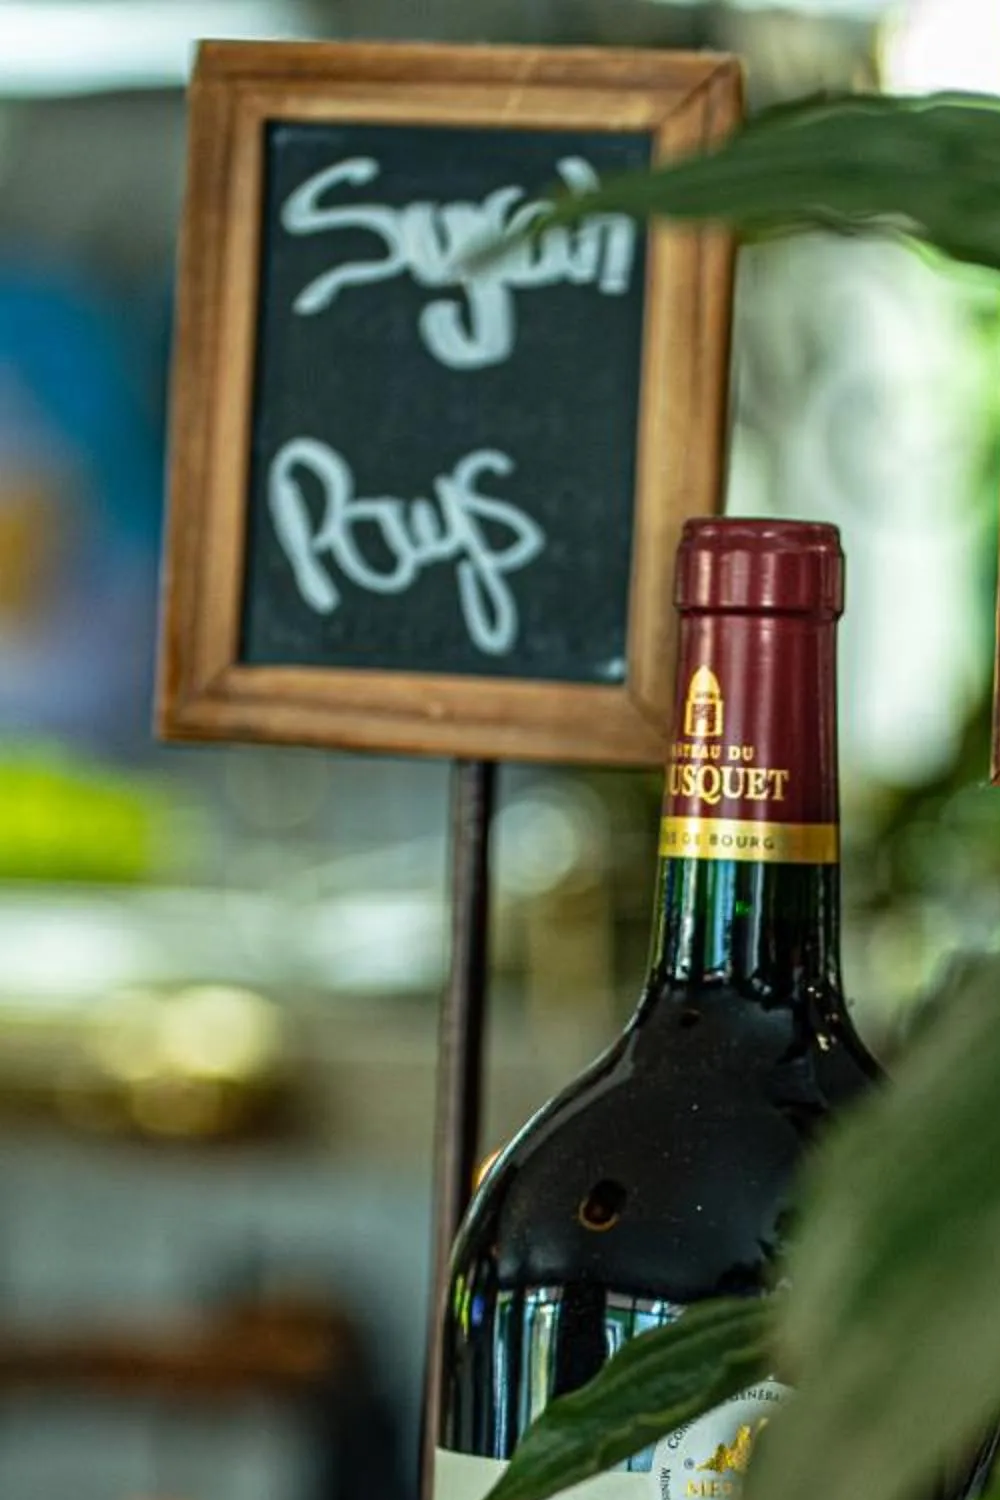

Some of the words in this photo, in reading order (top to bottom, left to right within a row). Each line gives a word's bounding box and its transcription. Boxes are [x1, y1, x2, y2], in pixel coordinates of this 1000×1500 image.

[268, 437, 545, 655] Pays
[727, 746, 754, 761] DU
[709, 833, 774, 850] BOURG
